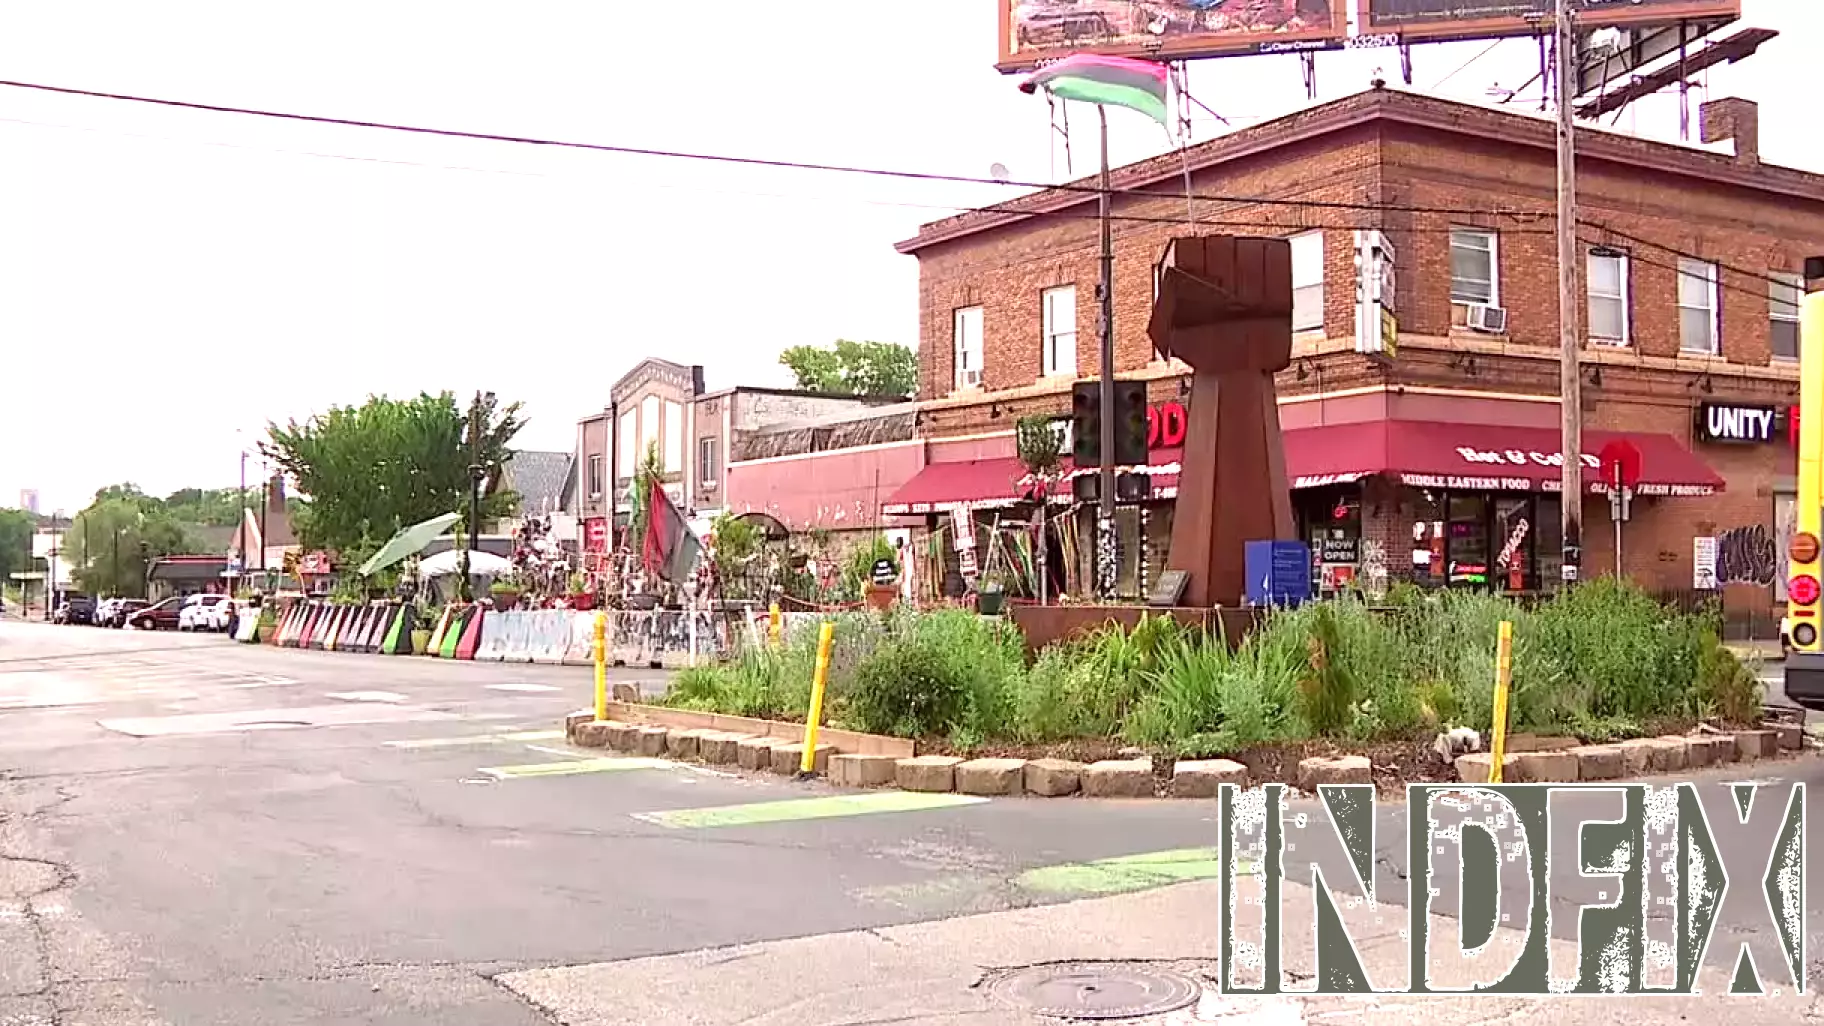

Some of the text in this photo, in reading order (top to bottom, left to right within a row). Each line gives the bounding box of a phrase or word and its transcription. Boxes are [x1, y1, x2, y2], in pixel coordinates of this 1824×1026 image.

[1708, 406, 1773, 440] UNITY
[1401, 473, 1531, 490] MIDDLE EASTERN FOOD
[1636, 484, 1669, 496] FRESH
[1671, 485, 1714, 498] PRODUCE
[1324, 539, 1354, 550] NOW
[1323, 551, 1355, 561] OPEN
